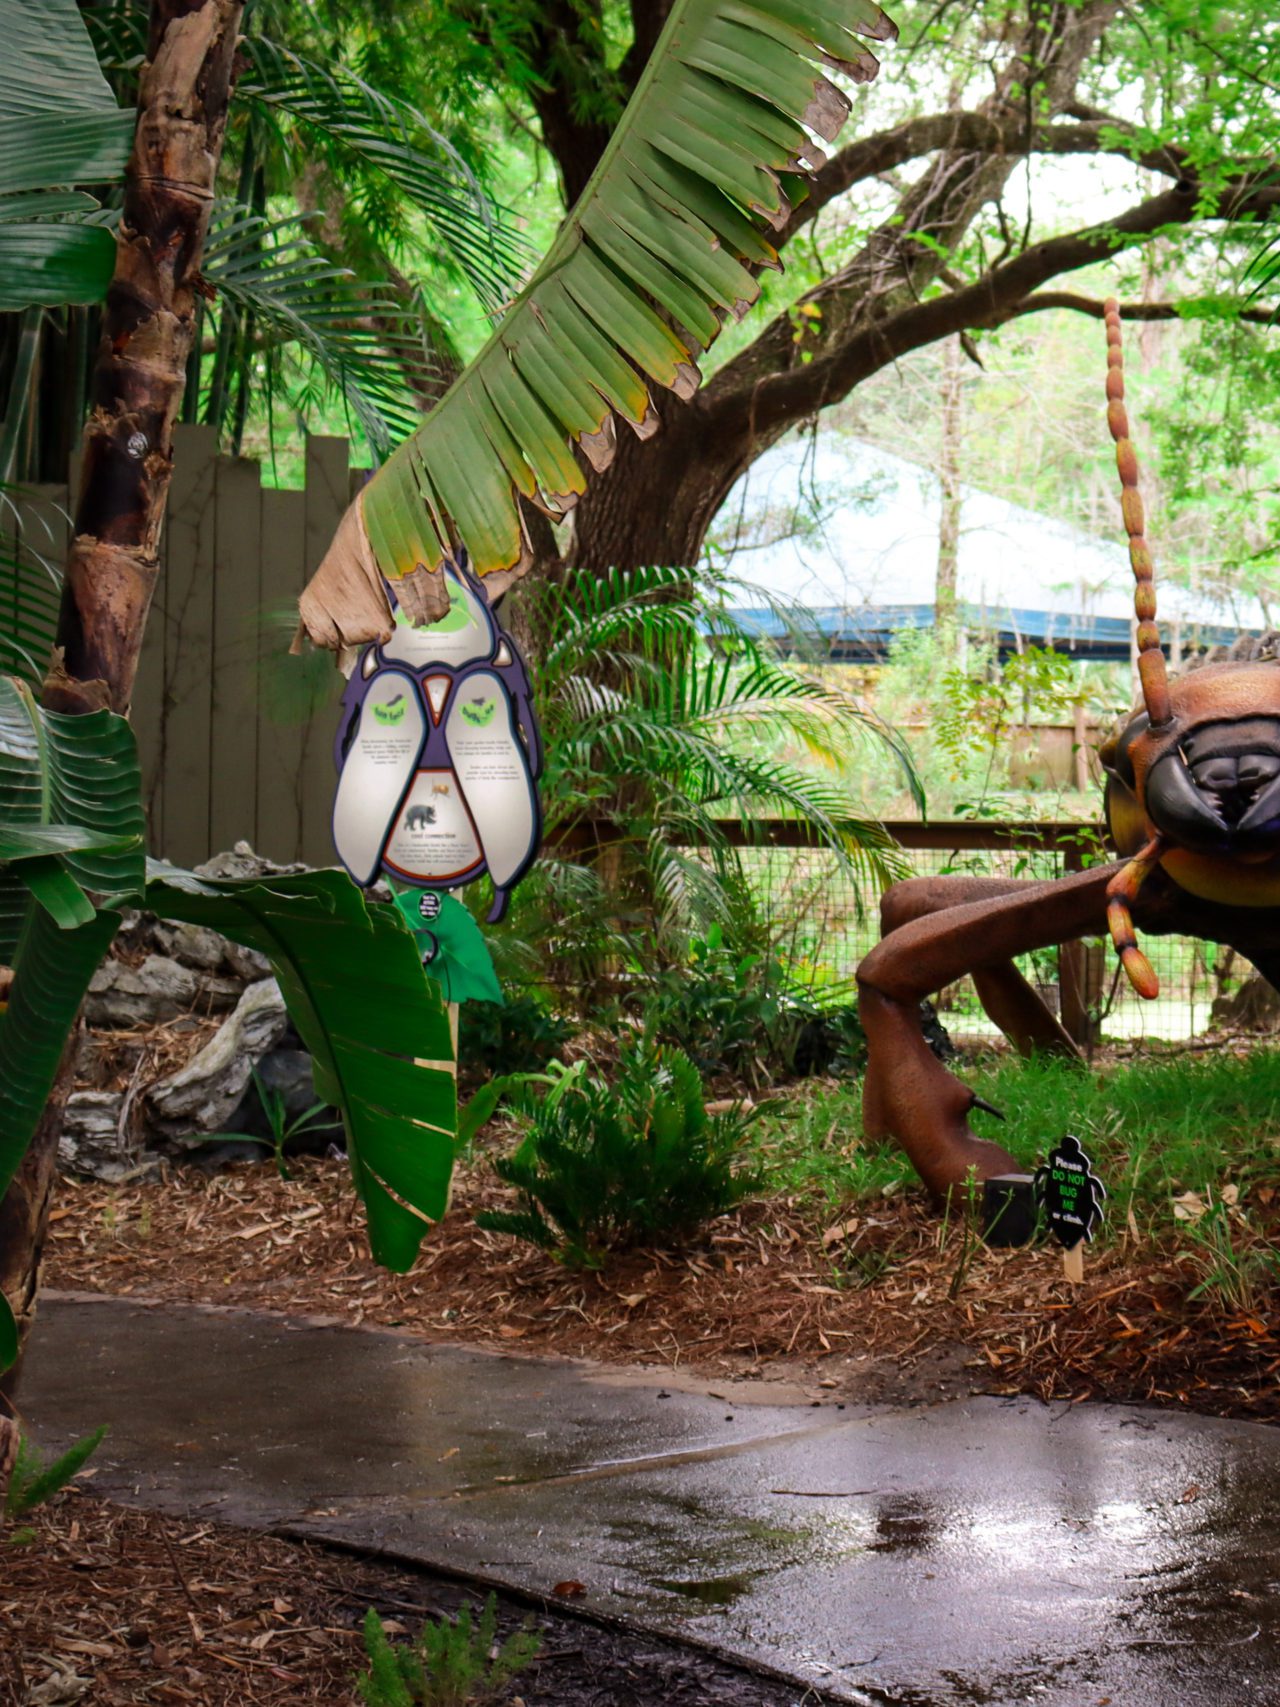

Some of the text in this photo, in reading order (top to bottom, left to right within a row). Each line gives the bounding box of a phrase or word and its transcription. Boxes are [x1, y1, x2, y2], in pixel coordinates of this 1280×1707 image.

[1055, 1156, 1083, 1172] Please
[1052, 1169, 1086, 1187] DO NOT
[1060, 1184, 1078, 1198] BUG
[1063, 1200, 1075, 1212] ME
[1052, 1212, 1061, 1220] or
